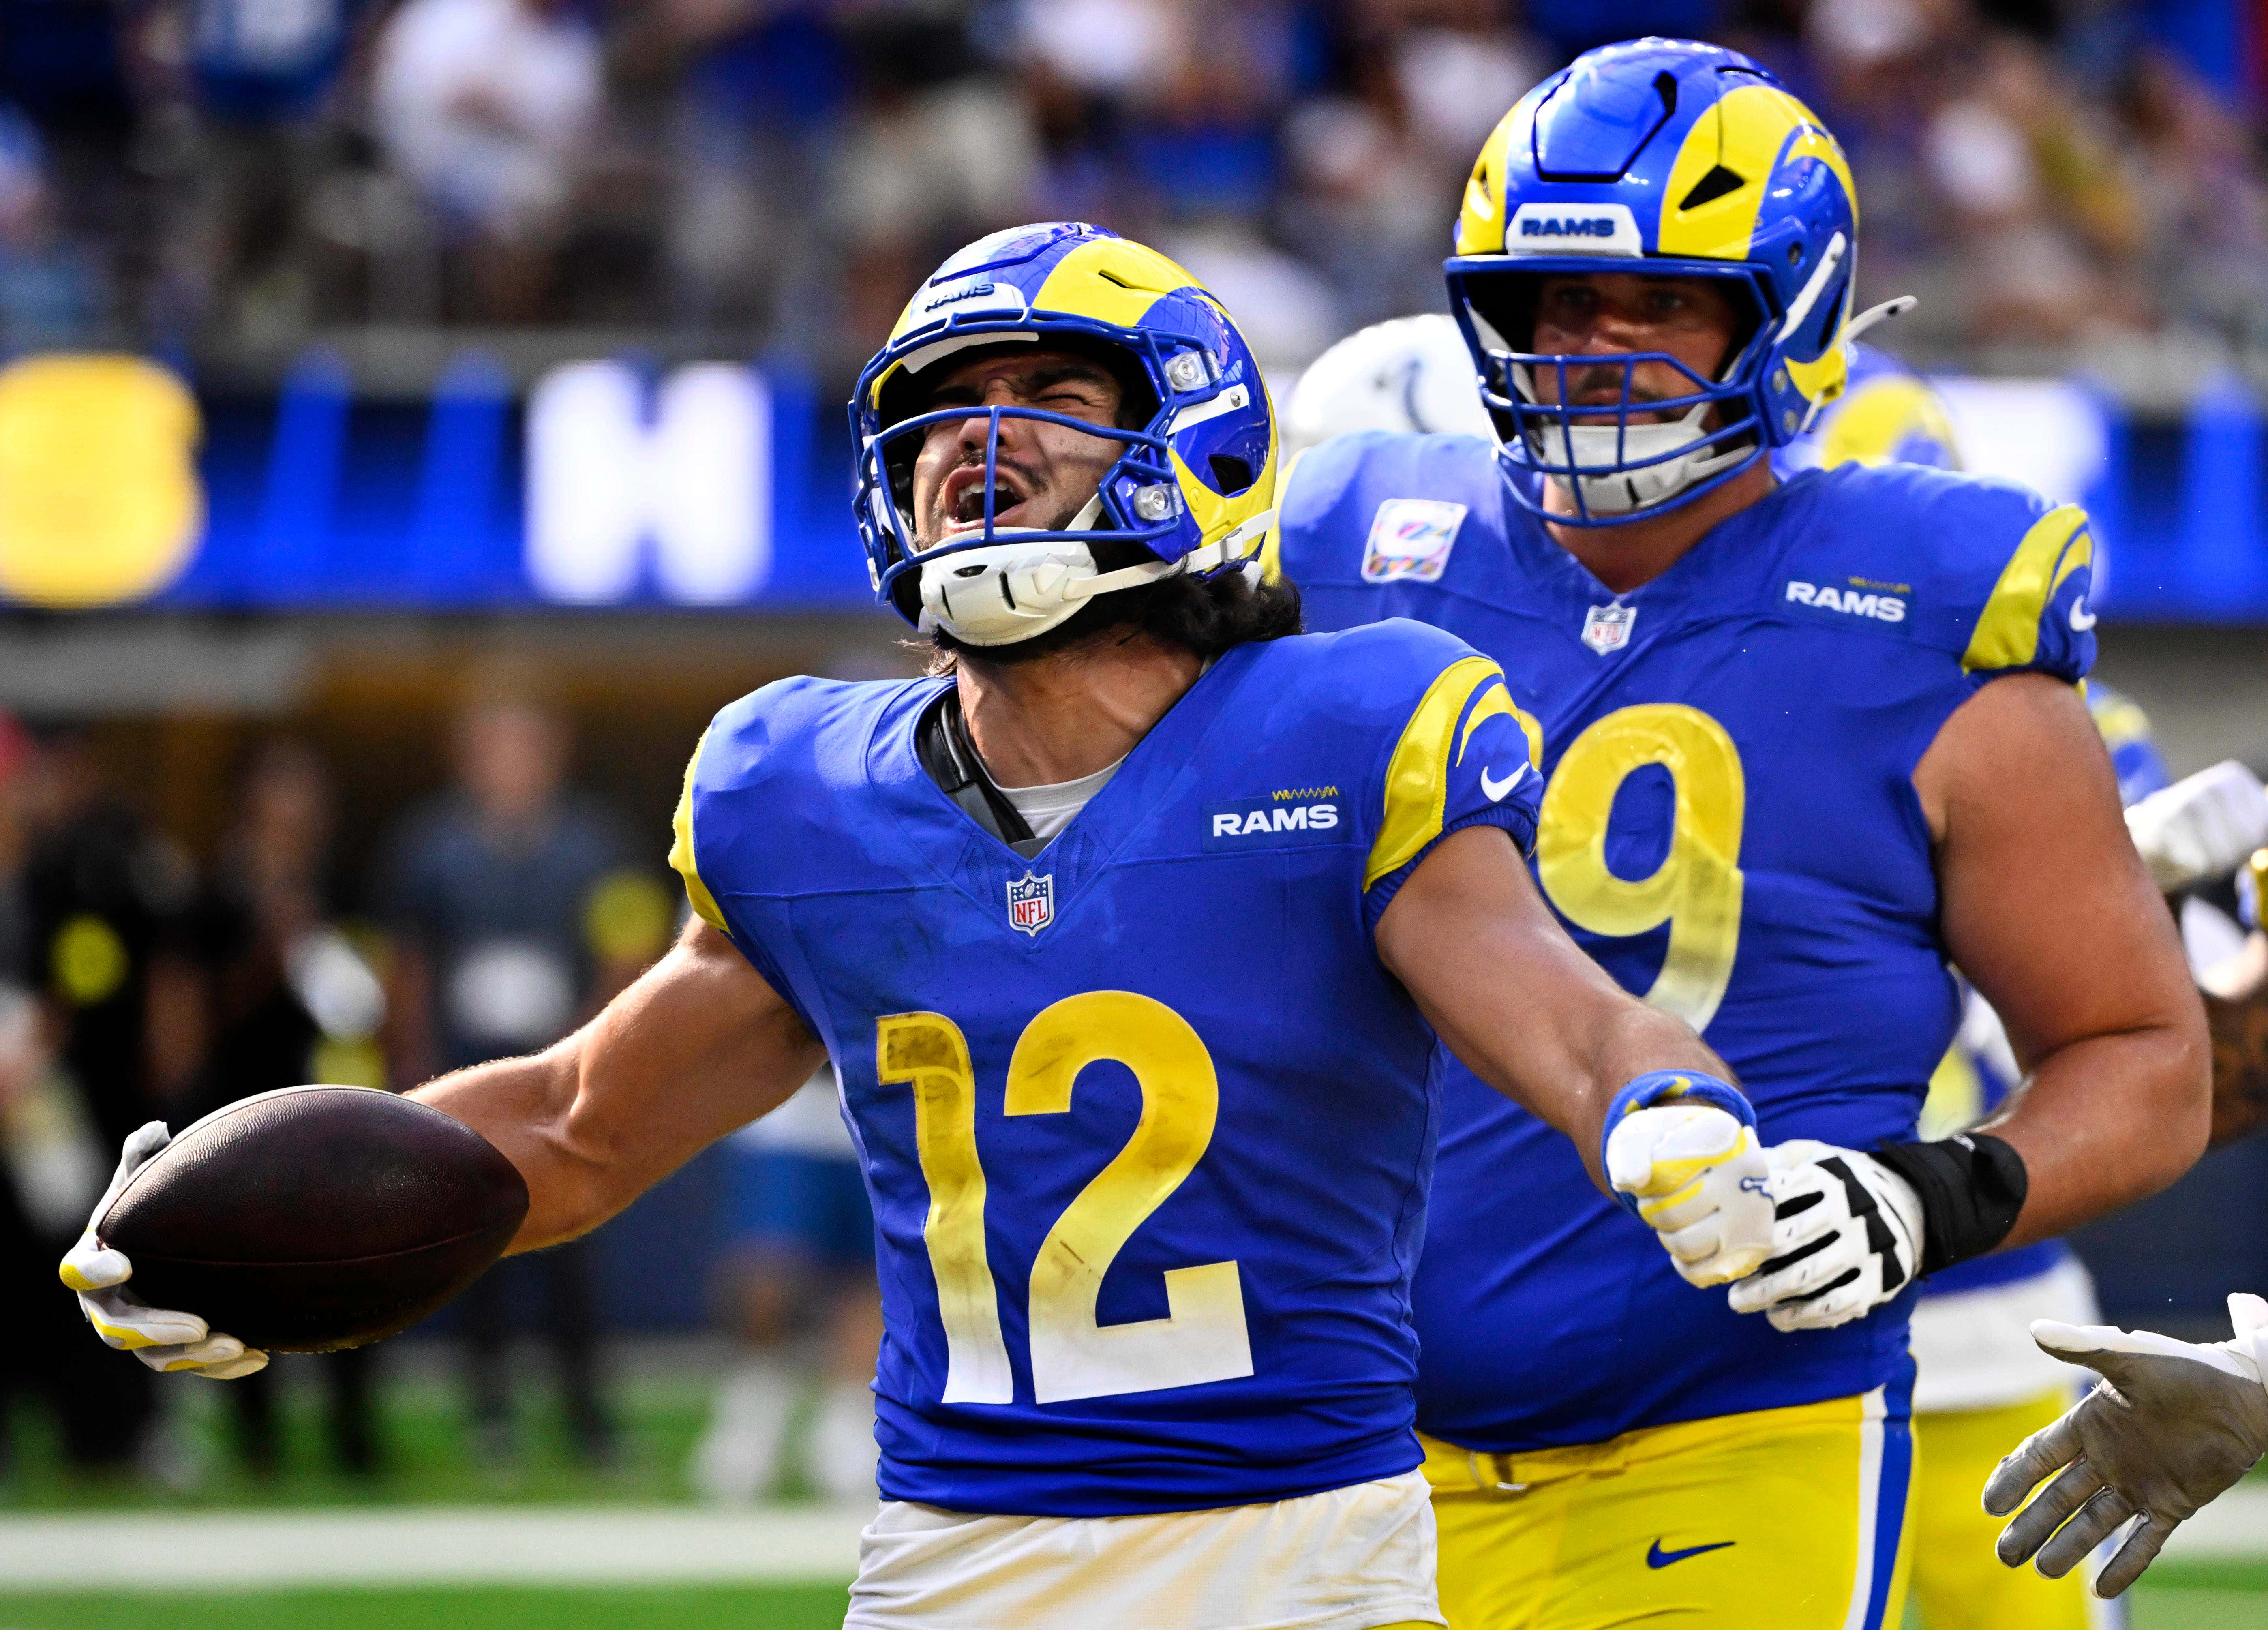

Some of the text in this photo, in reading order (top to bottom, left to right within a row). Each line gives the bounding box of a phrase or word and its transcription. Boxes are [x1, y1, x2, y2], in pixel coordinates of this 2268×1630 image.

[1521, 218, 1615, 237] RAMS
[924, 283, 995, 313] RAMS
[1786, 581, 1906, 623] RAMS
[1214, 805, 1338, 837] RAMS
[1518, 703, 1745, 1034] 9
[1015, 900, 1046, 925] NFL
[876, 990, 1254, 1404] 12
